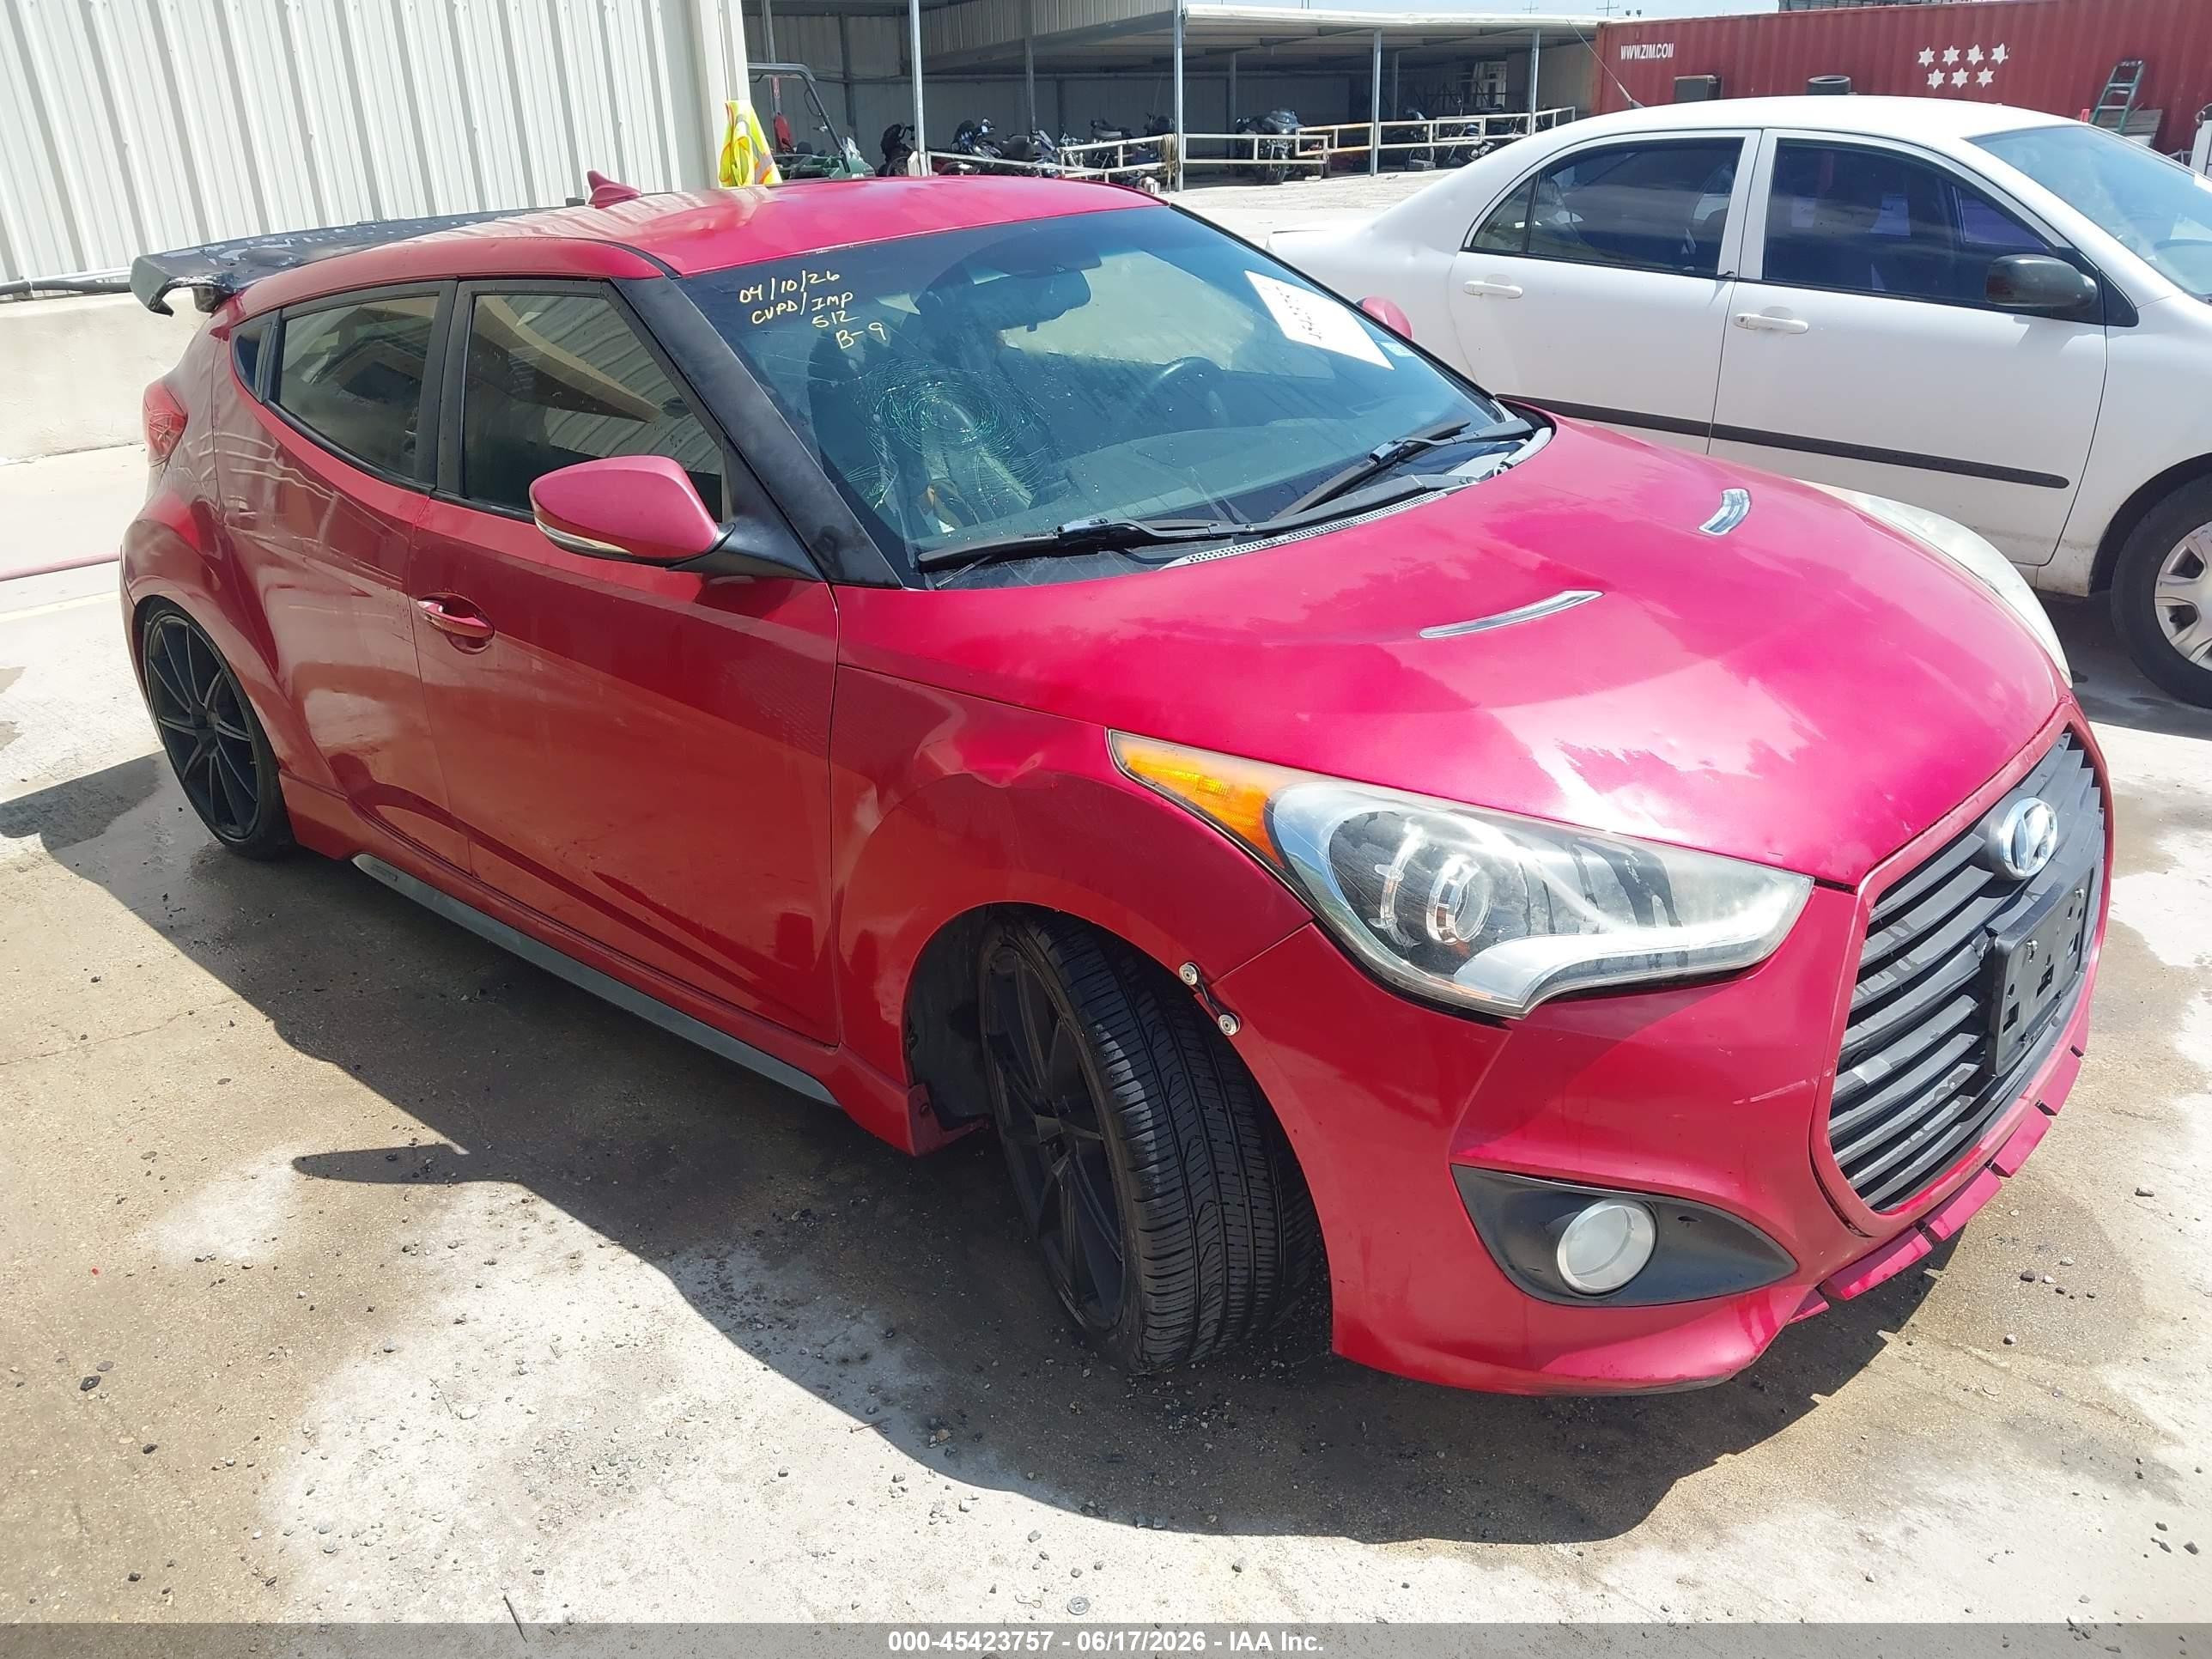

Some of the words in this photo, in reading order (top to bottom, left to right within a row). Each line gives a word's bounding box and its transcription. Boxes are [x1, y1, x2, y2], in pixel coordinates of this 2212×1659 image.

[738, 270, 840, 303] 04/10/26
[811, 310, 860, 328] 512
[835, 322, 887, 349] B-9
